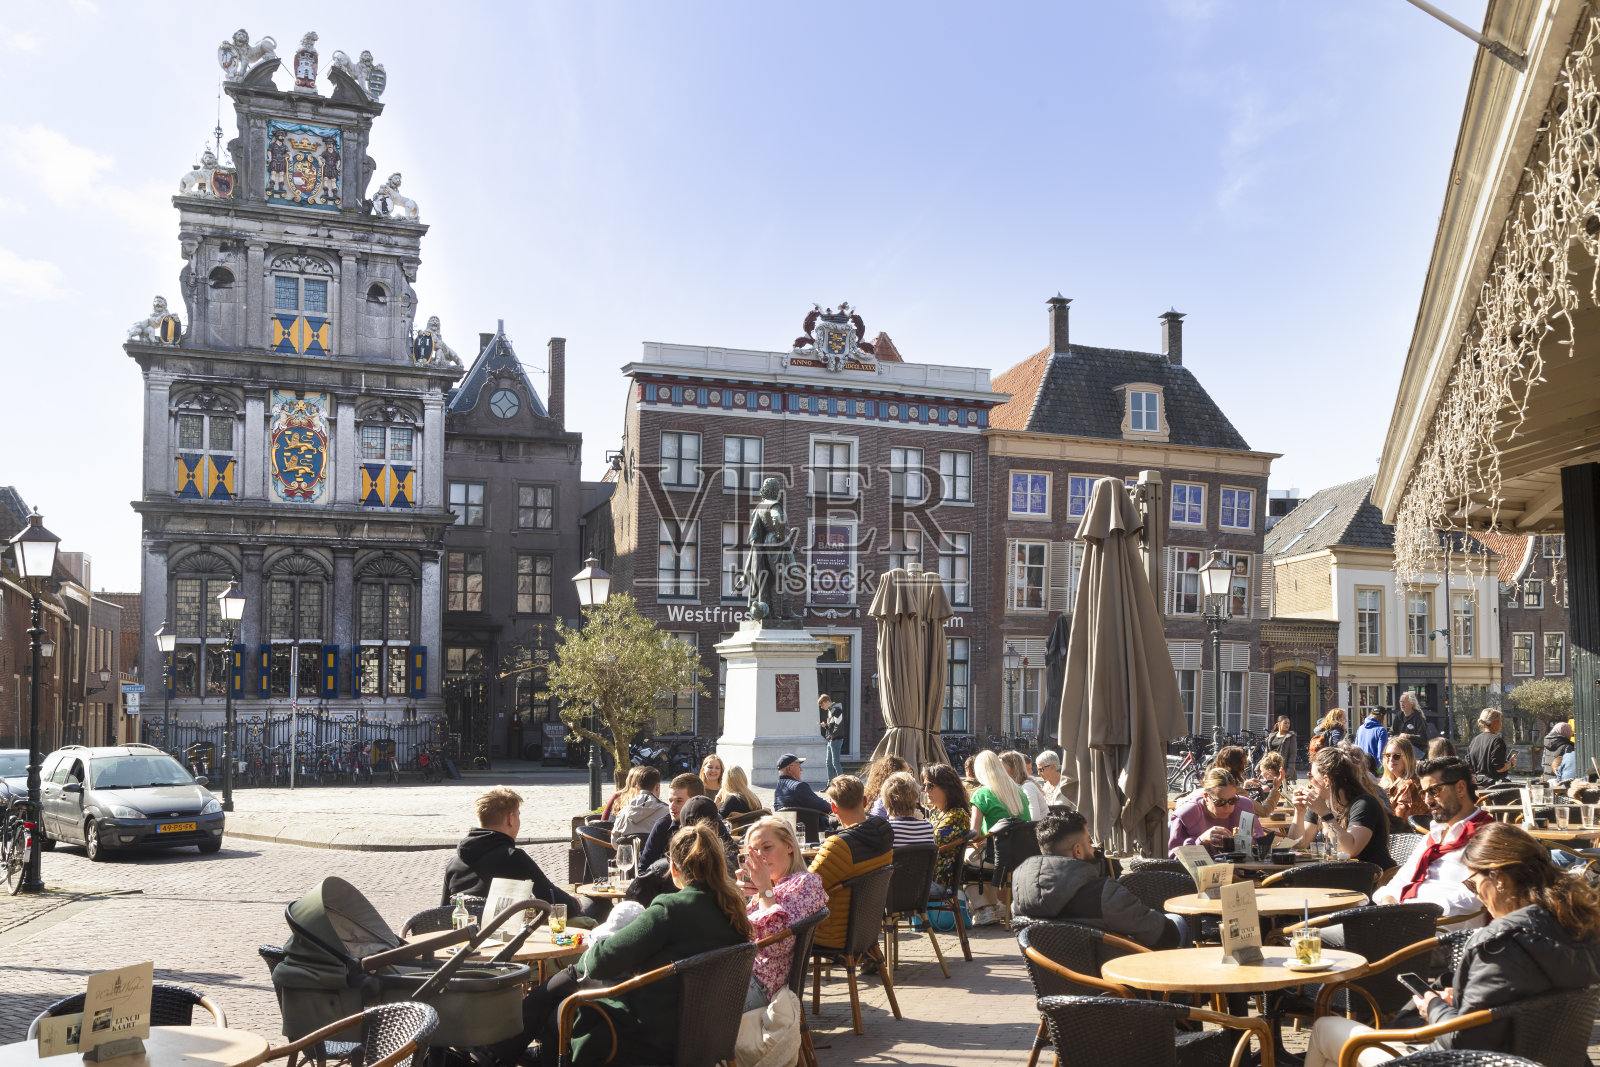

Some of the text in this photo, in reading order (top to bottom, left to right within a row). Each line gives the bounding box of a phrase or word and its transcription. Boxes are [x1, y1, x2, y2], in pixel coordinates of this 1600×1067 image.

[667, 605, 752, 623] Westfries
[115, 1013, 140, 1025] LUNCH
[112, 1021, 136, 1032] KAART
